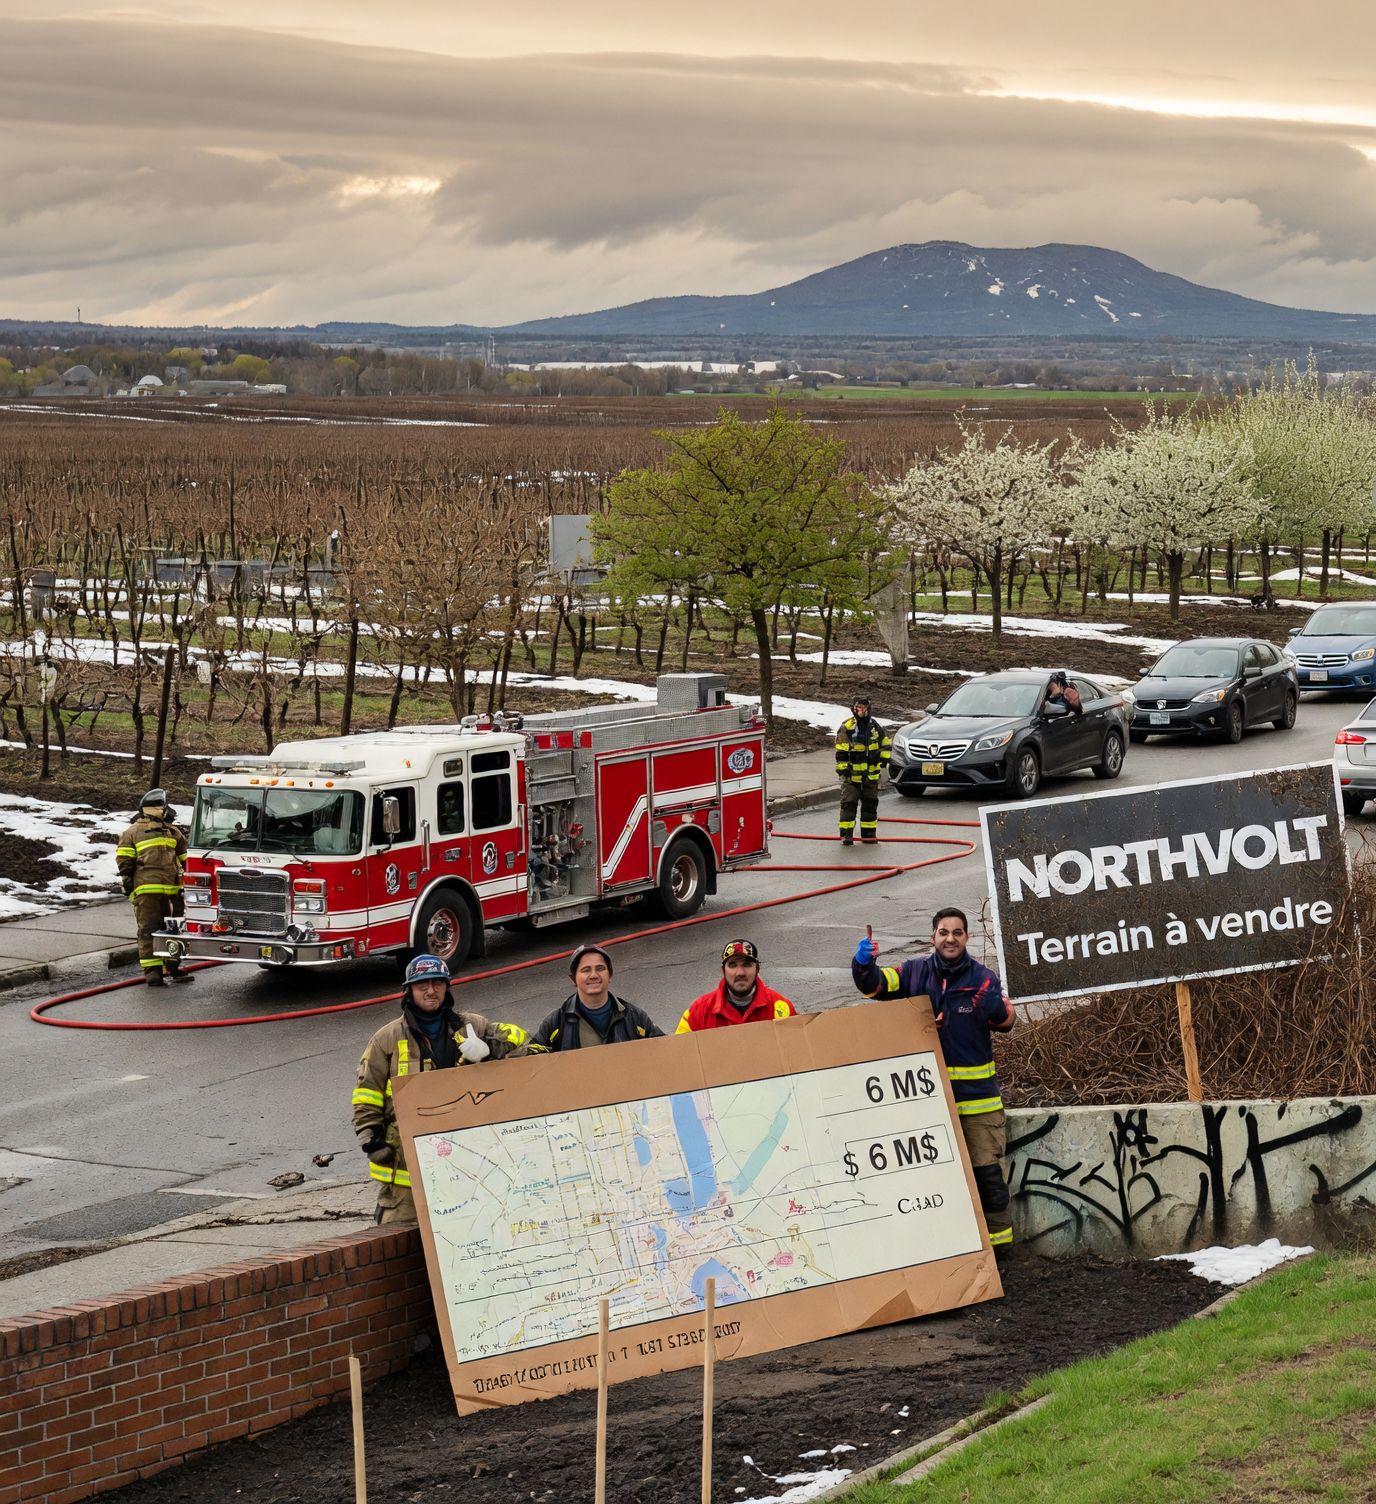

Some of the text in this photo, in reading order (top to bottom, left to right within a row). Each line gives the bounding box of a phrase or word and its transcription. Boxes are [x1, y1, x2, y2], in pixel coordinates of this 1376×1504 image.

[1005, 814, 1328, 902] NORTHVOLT
[1016, 896, 1333, 966] Terrain à vendre
[865, 1065, 936, 1103] 6 M$
[843, 1131, 939, 1180] $ 6 M$
